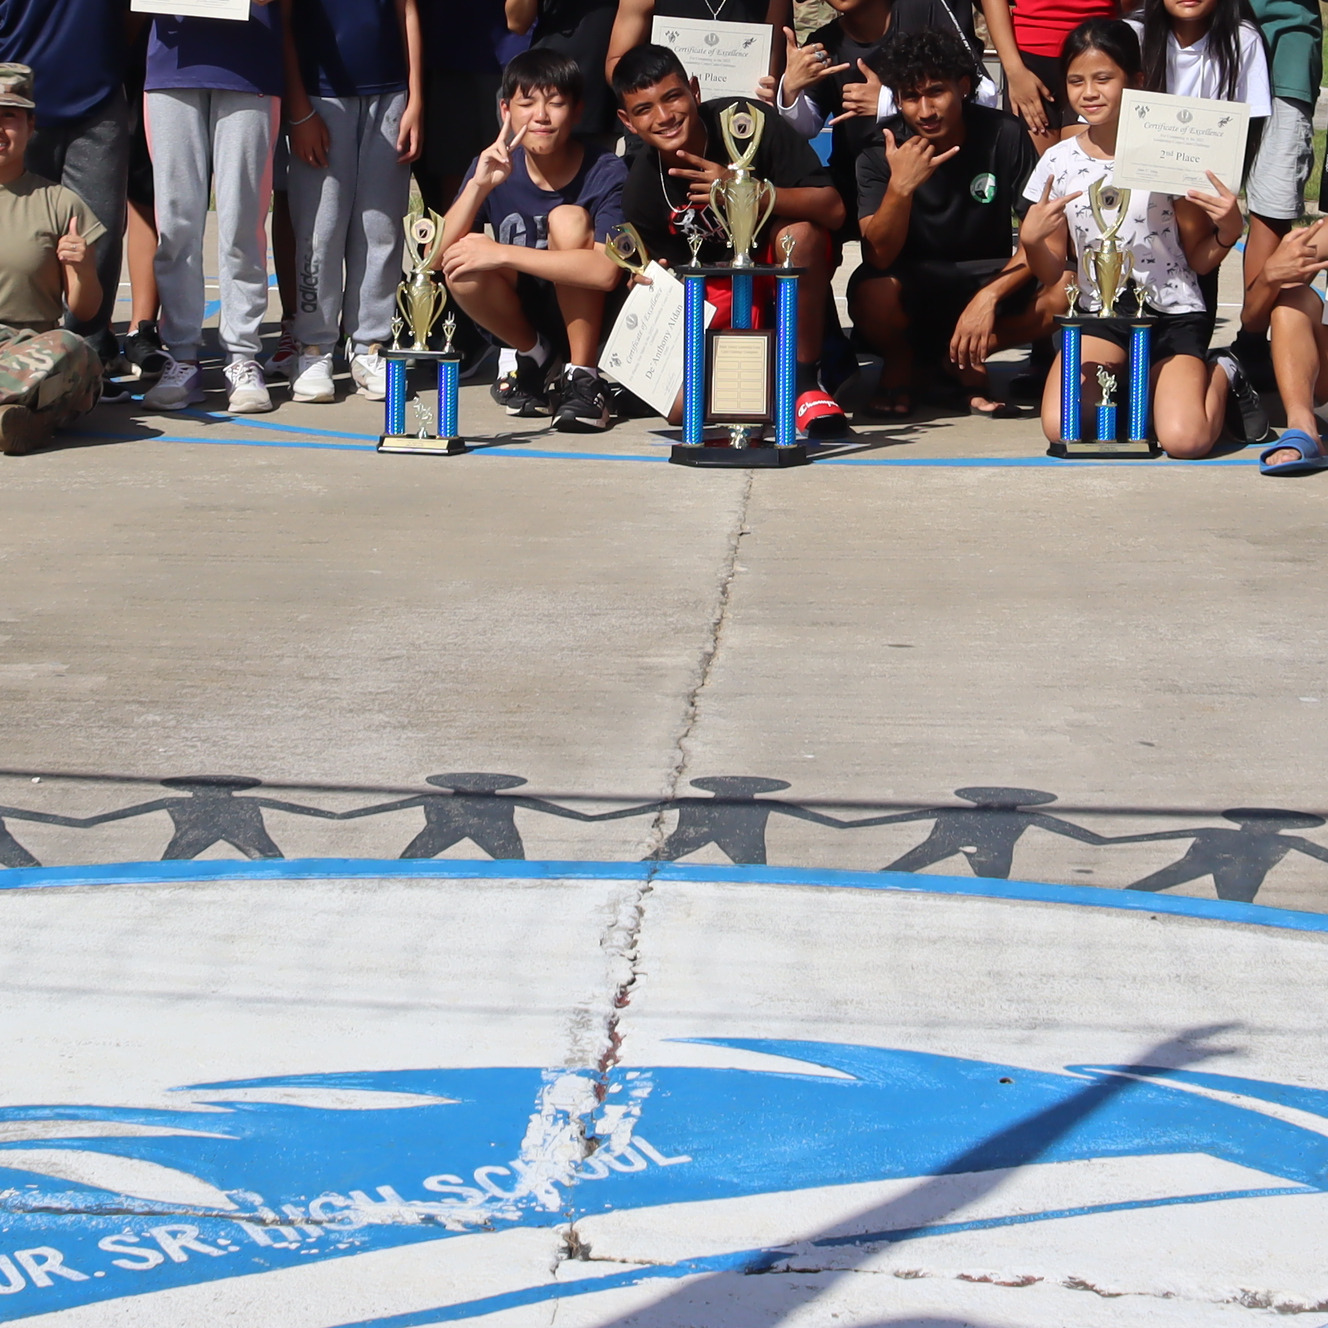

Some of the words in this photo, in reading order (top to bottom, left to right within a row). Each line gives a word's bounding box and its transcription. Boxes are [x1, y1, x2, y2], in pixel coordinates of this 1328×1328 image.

[673, 45, 707, 55] Certificate
[707, 47, 715, 57] of
[717, 48, 749, 58] Excellence
[704, 72, 728, 83] Place
[1143, 121, 1179, 132] Certificate
[1180, 126, 1188, 136] of
[1189, 127, 1224, 138] Excellence
[1160, 150, 1174, 160] 2nd
[1175, 151, 1201, 164] Place
[625, 330, 644, 365] Certificate
[640, 321, 648, 332] of
[644, 286, 663, 323] Excellence
[667, 304, 683, 331] Aldan
[97, 1220, 239, 1271] SR.
